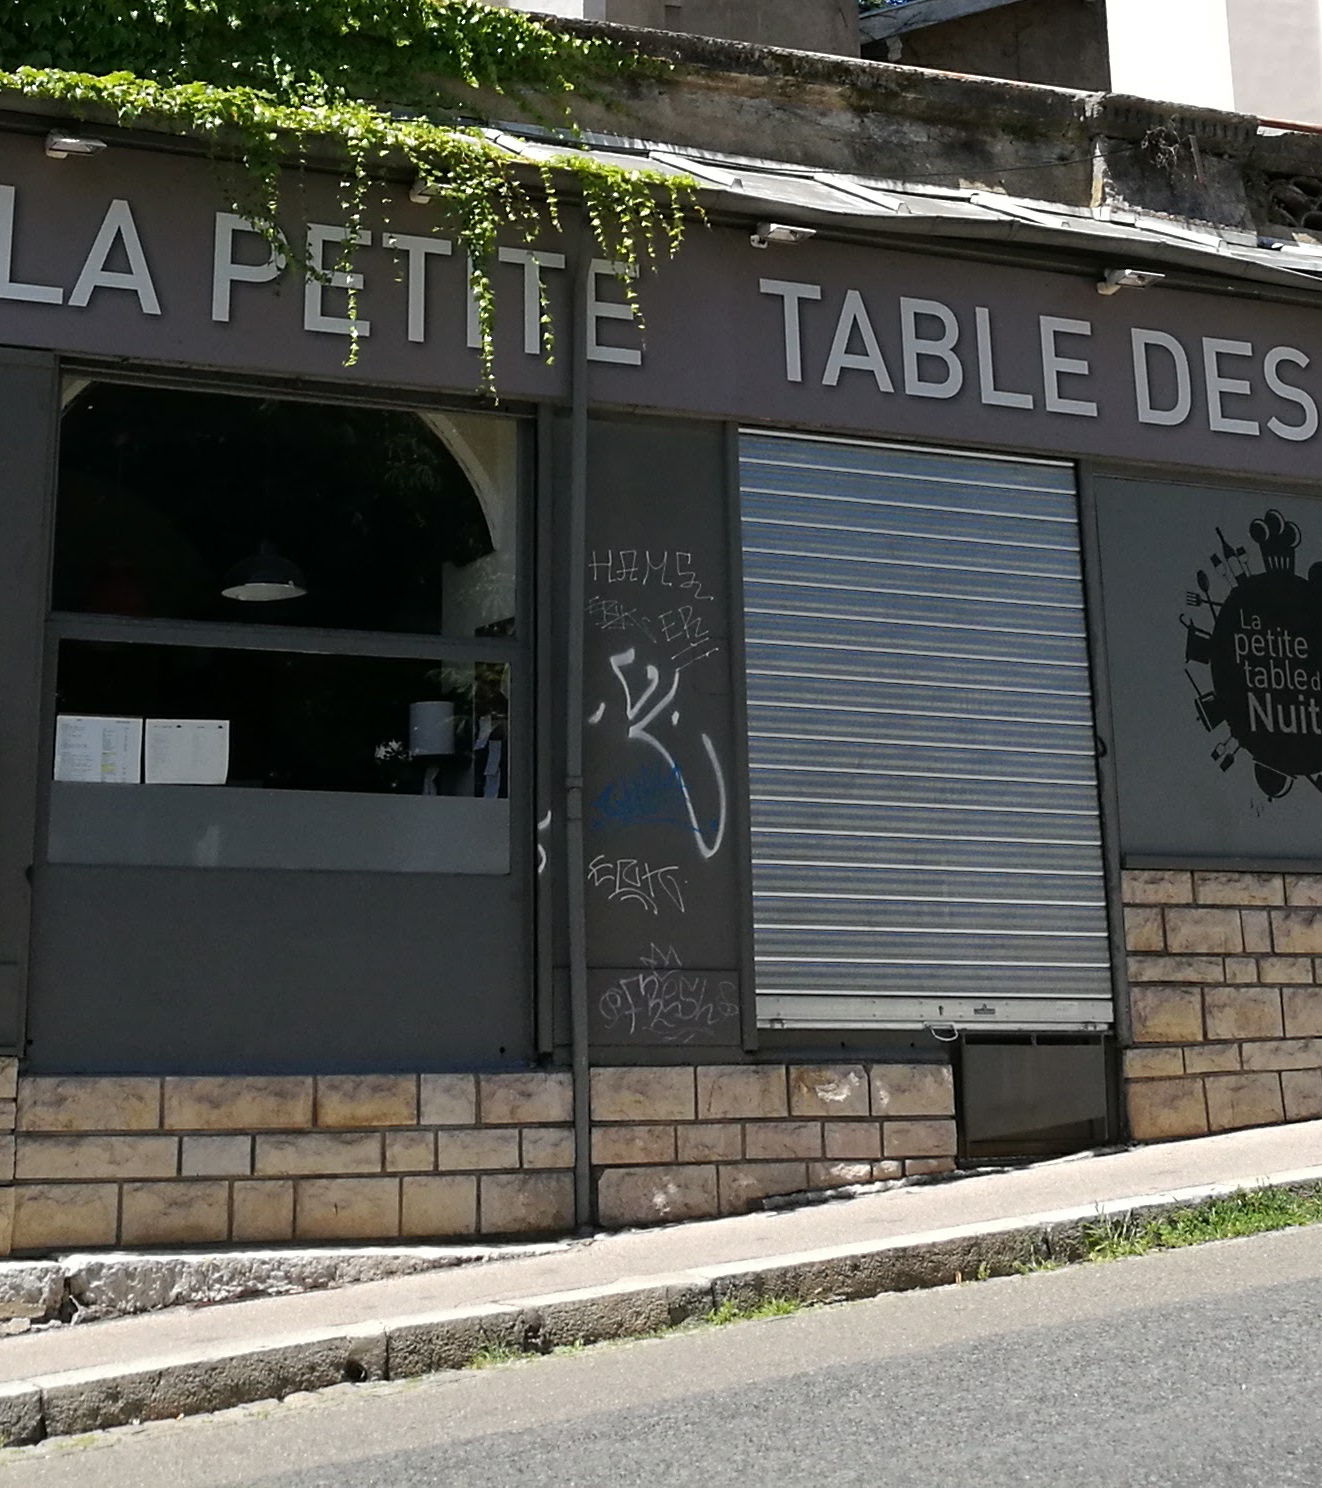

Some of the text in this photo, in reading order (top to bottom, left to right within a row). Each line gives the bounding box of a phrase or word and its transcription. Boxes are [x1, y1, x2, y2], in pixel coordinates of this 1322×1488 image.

[211, 211, 644, 366] PETITE
[759, 277, 1098, 418] TABLE
[1131, 327, 1320, 443] DES
[1240, 609, 1261, 630] La
[1233, 627, 1309, 663] petite
[1243, 659, 1309, 690] table
